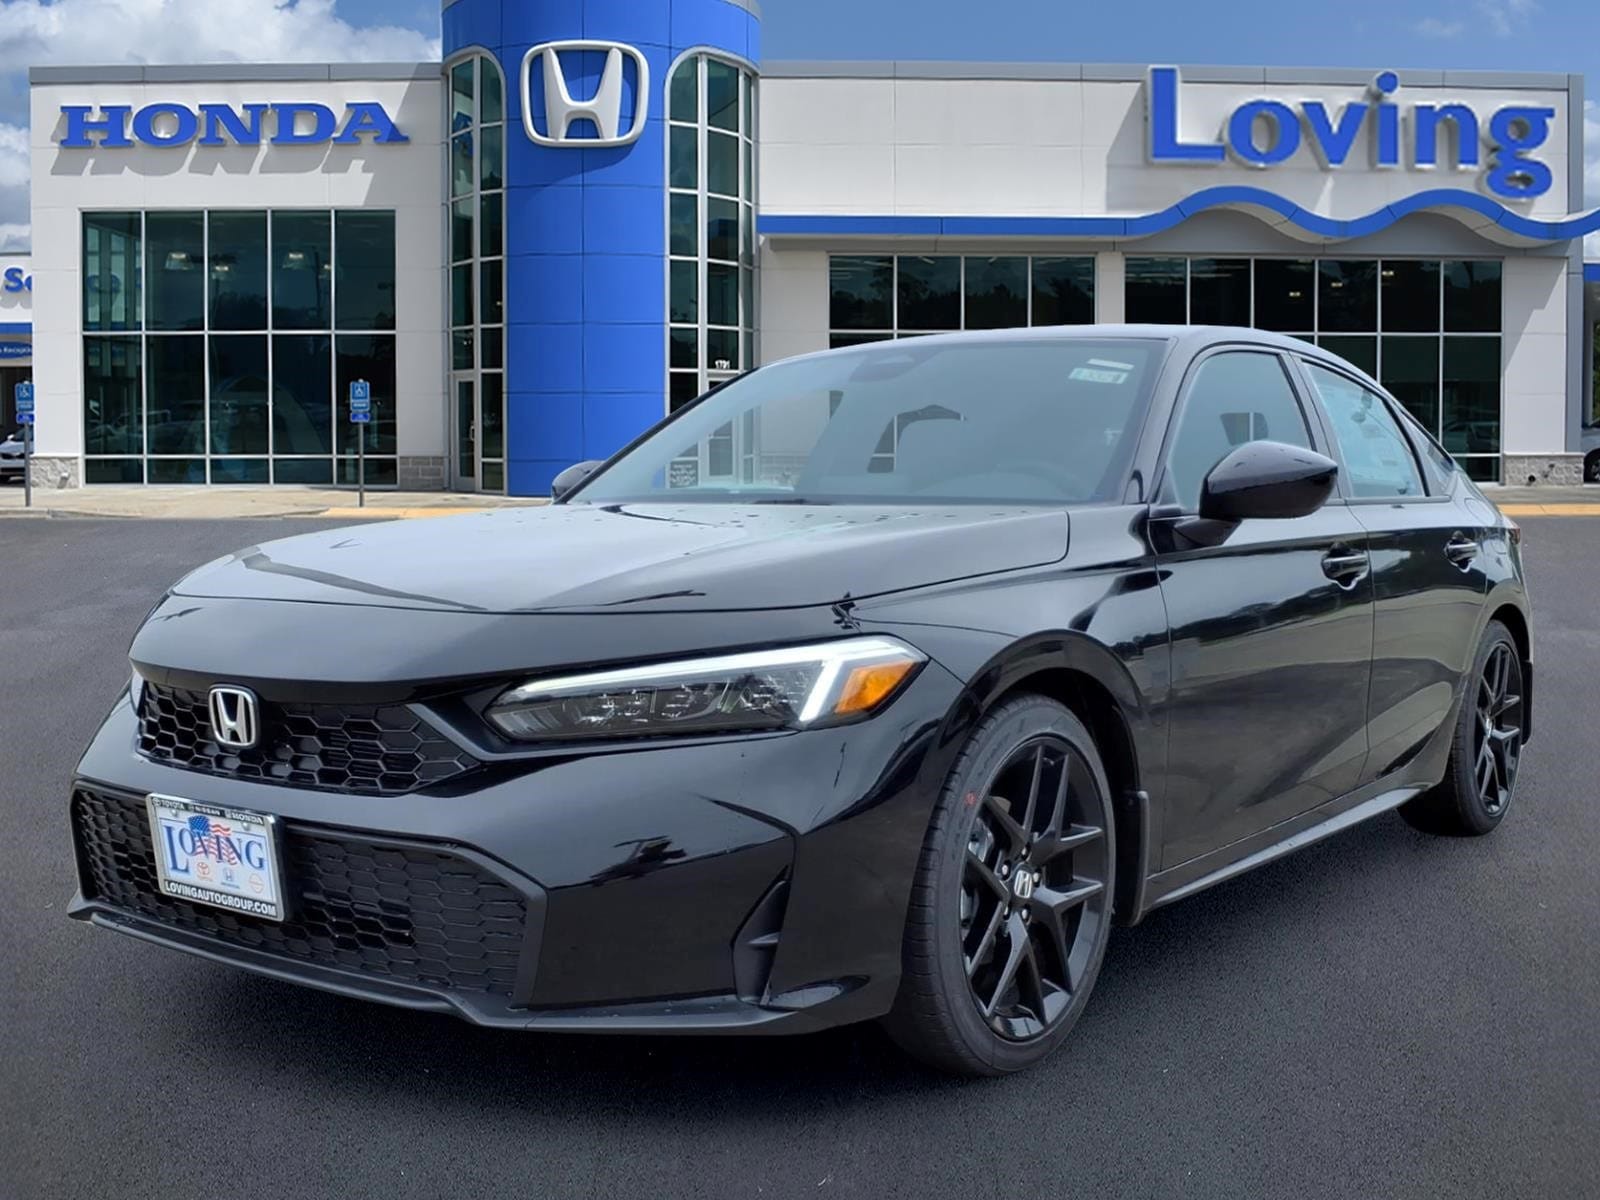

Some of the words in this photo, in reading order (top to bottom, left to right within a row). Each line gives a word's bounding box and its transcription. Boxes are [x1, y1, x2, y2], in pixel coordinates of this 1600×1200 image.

[60, 101, 410, 148] HONDA
[1148, 65, 1556, 198] Loving
[160, 800, 185, 811] TOYOTA
[194, 805, 221, 816] NISSAN
[231, 811, 264, 825] HONDA
[163, 824, 265, 874] LOVING
[164, 880, 278, 917] LOVINGAUTOGROUP.COM
